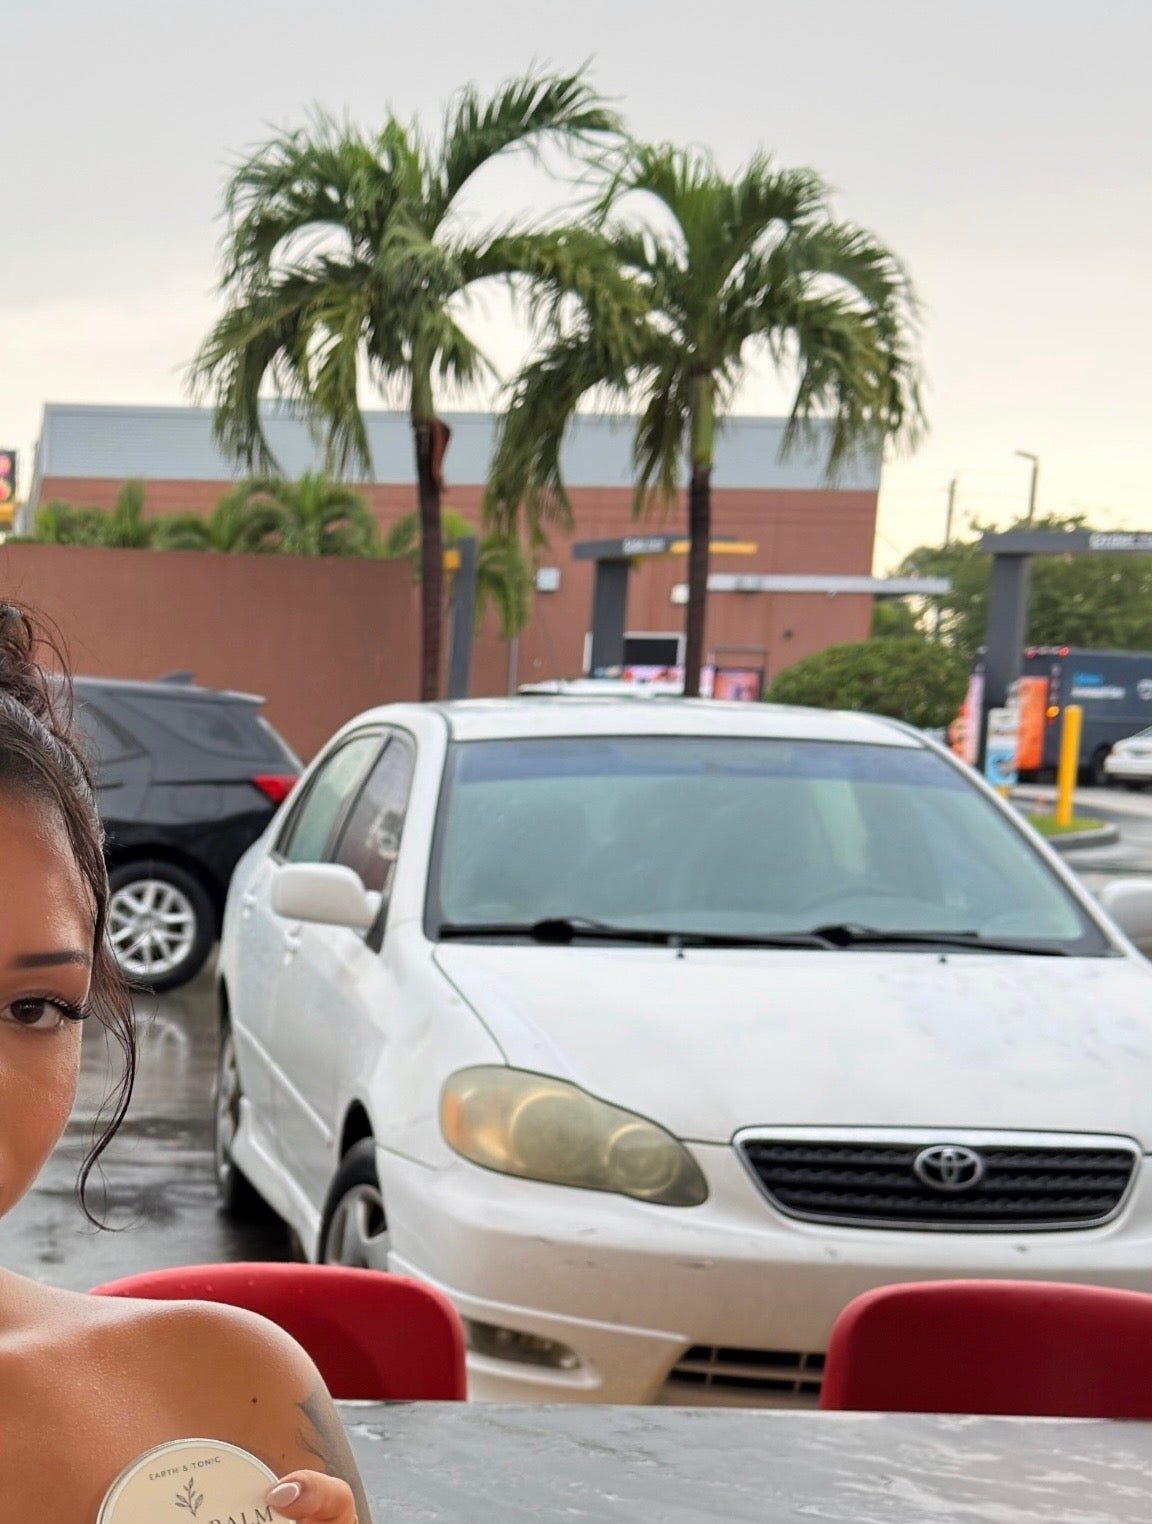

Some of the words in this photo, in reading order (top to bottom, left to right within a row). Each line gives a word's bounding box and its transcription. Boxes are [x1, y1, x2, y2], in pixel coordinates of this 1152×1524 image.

[149, 1467, 179, 1481] EARTH
[182, 1464, 189, 1472] &
[192, 1456, 221, 1469] TONIC
